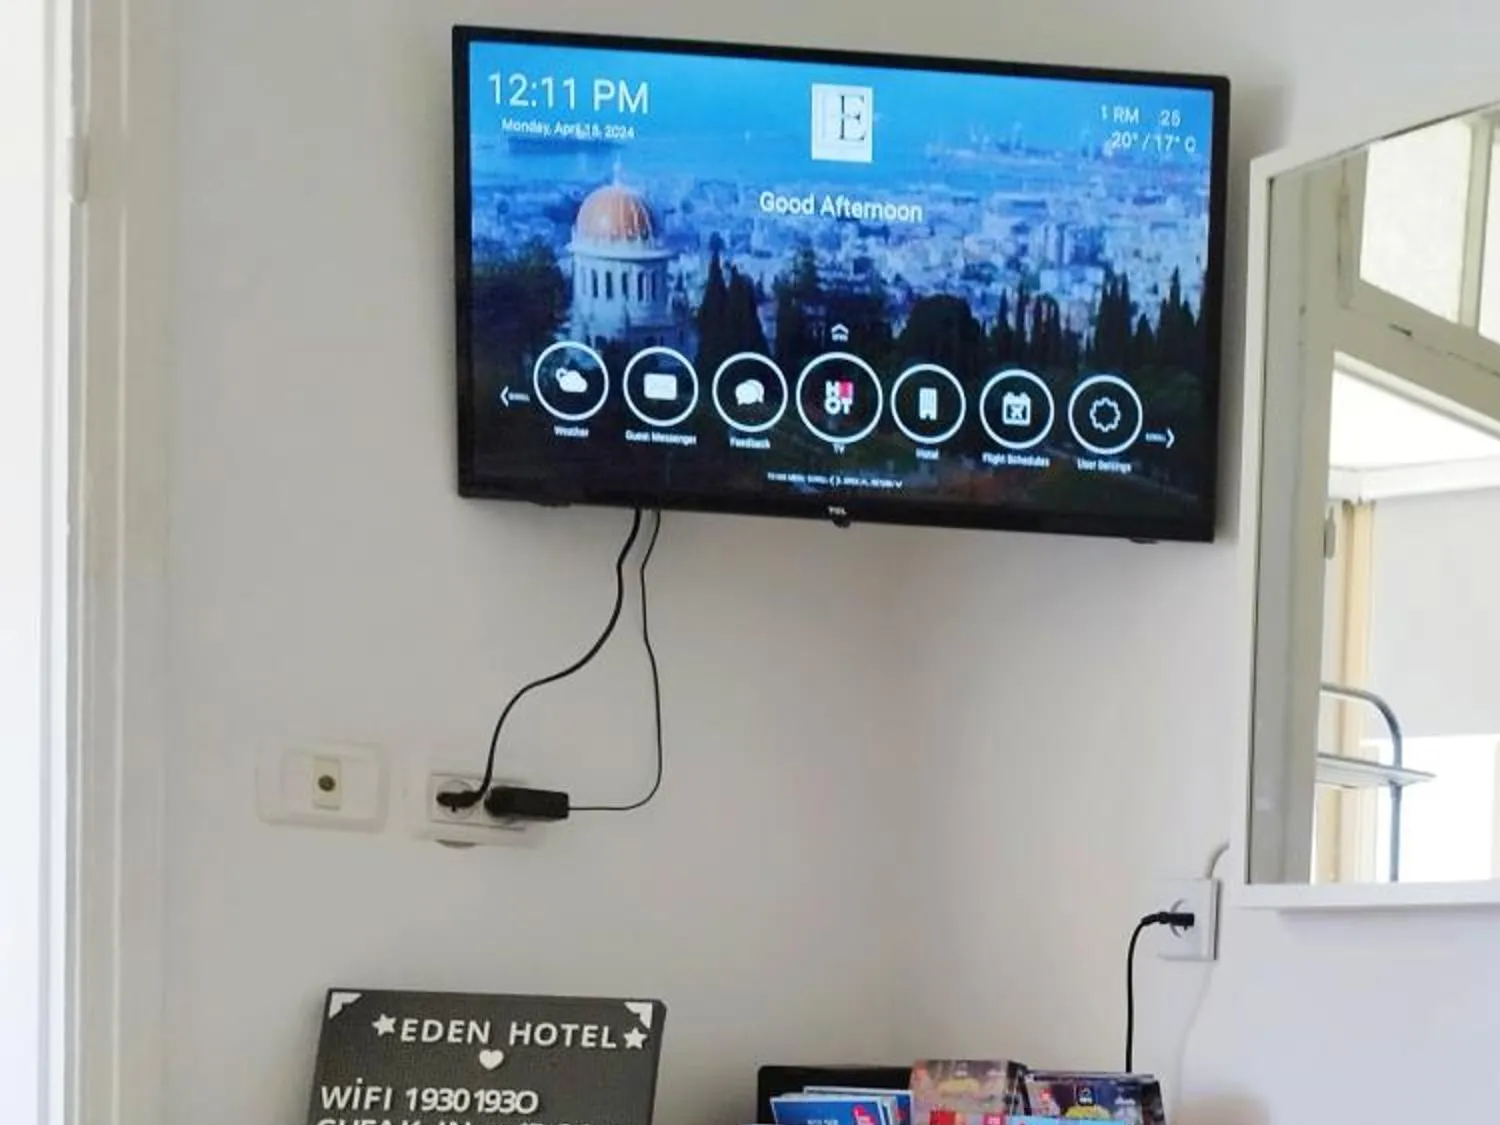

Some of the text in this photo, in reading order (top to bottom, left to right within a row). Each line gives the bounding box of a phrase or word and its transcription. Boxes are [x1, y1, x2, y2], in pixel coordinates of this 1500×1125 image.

[488, 73, 650, 114] 12:11 PM
[759, 190, 924, 223] Good Afternoon
[400, 1018, 617, 1050] EDEN HOTEL
